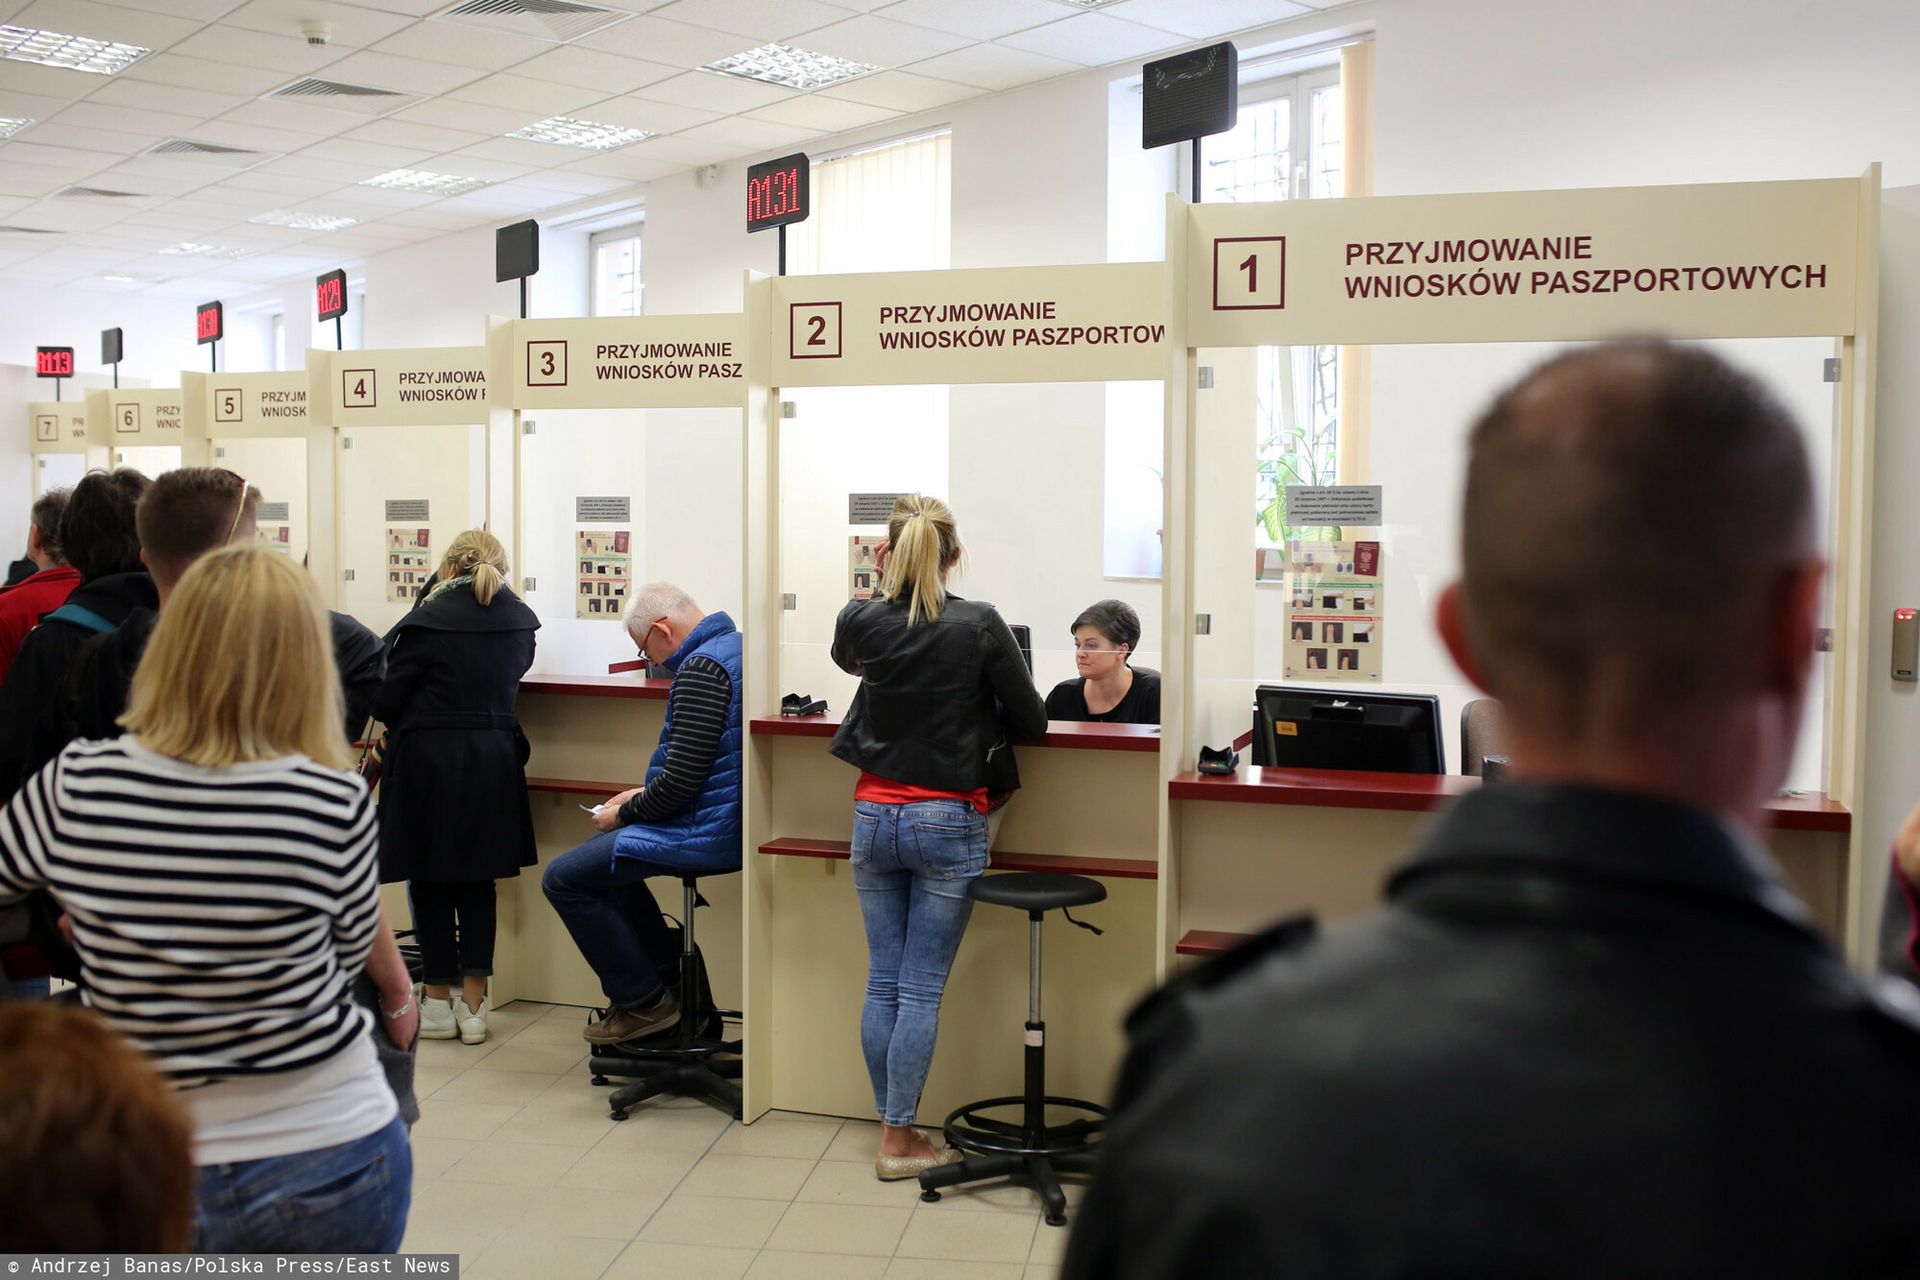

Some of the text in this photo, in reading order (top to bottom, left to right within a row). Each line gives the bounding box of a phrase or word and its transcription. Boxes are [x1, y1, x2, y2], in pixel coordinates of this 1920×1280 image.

[747, 168, 800, 222] A131
[1346, 236, 1592, 265] PRZYJMOWANIE
[1239, 255, 1257, 293] 1
[1345, 264, 1827, 298] WNIOSKÓW PASZPORTOWYCH
[317, 278, 342, 314] A129
[880, 302, 1056, 324] PRZYJMOWANIE
[807, 315, 826, 346] 2
[879, 325, 1165, 350] WNIOSKÓW PASZPORTOW
[596, 343, 732, 359] PRZYJMOWANIE
[36, 352, 73, 375] A113
[540, 351, 556, 377] 3
[596, 362, 743, 380] WNIOSKÓW PASZ
[399, 371, 486, 384] PRZYJMOWA
[261, 391, 306, 402] PRZYJM
[353, 378, 367, 399] 4
[399, 386, 478, 402] WNIOSKÓW
[224, 397, 235, 415] 5
[261, 406, 307, 417] WNIOSK
[43, 421, 52, 435] 7
[124, 410, 133, 426] 6
